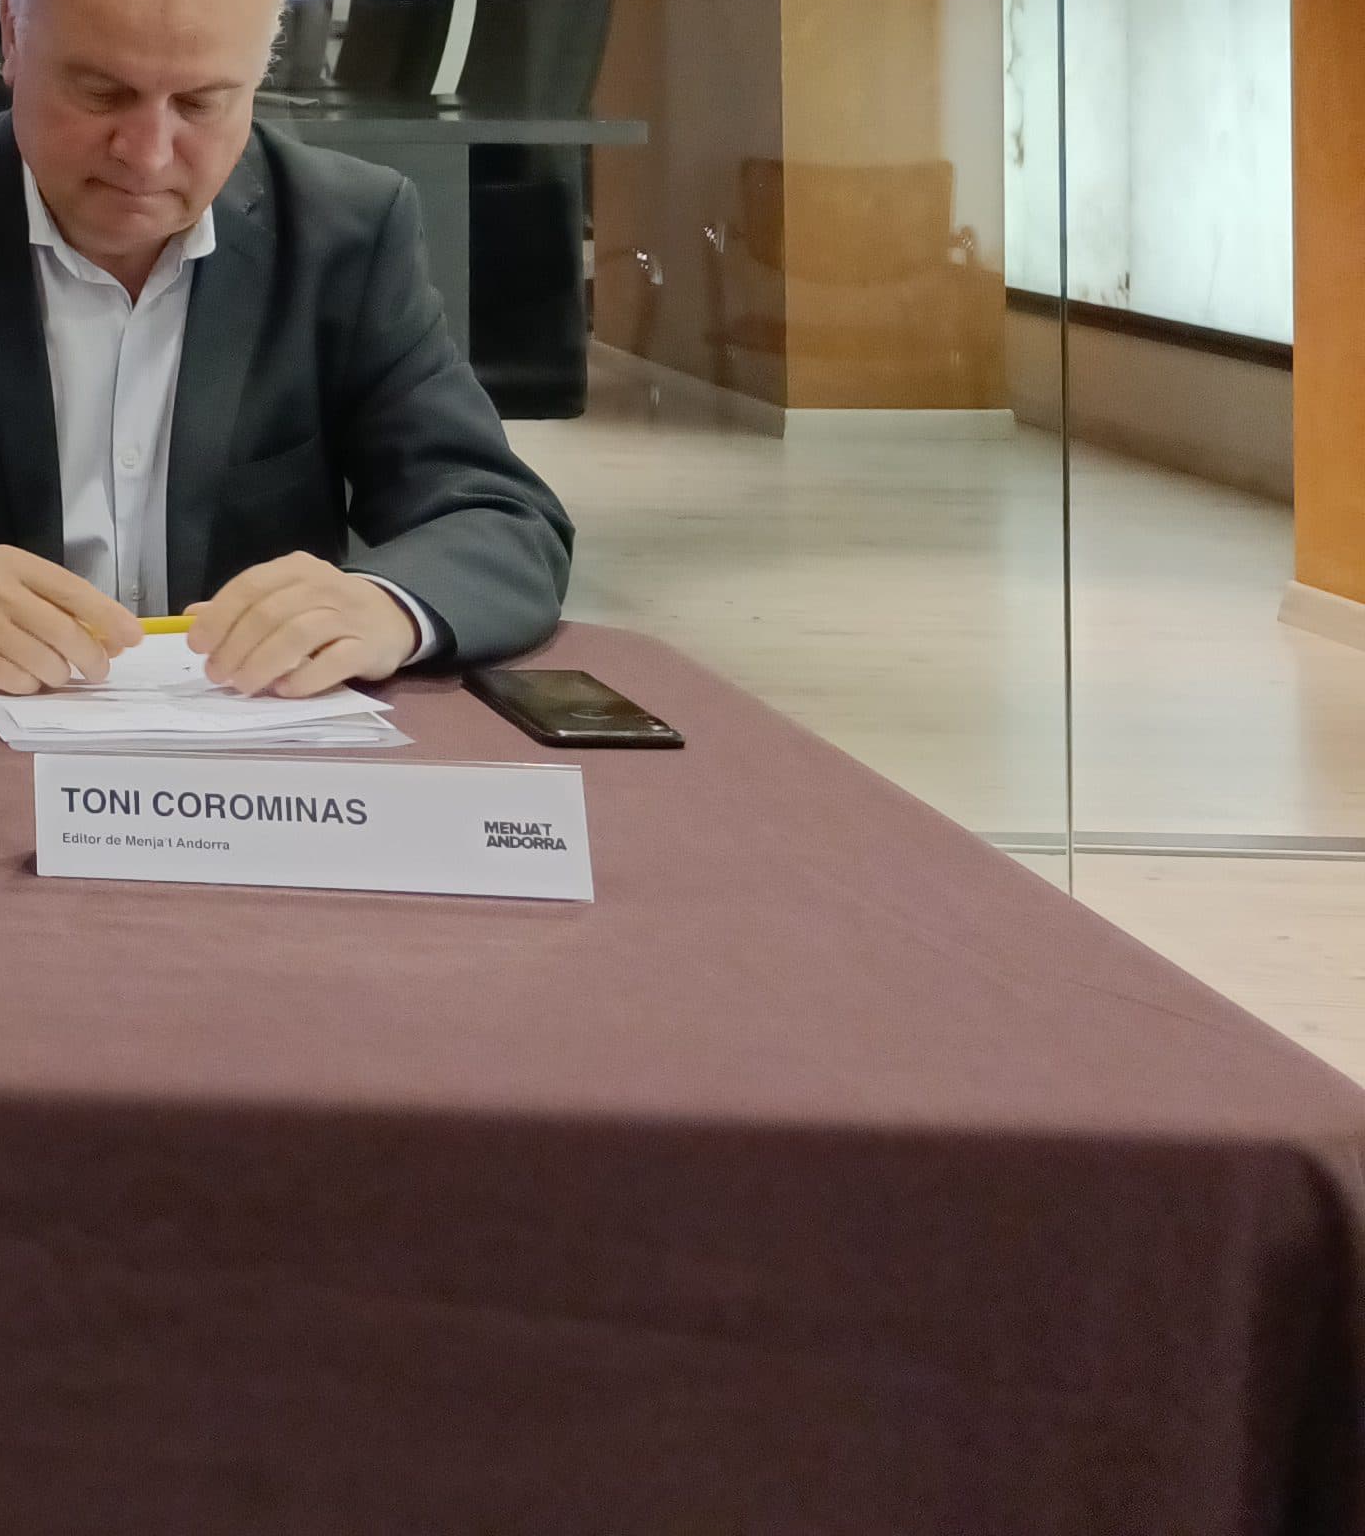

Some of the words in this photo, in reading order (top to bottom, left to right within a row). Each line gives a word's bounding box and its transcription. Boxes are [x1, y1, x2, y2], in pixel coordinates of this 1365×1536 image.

[61, 786, 141, 816] TONI
[152, 790, 368, 826] COROMINAS
[62, 832, 101, 845] Editor
[105, 834, 121, 846] de
[176, 837, 230, 851] Andorra
[486, 834, 567, 851] ANDORRA
